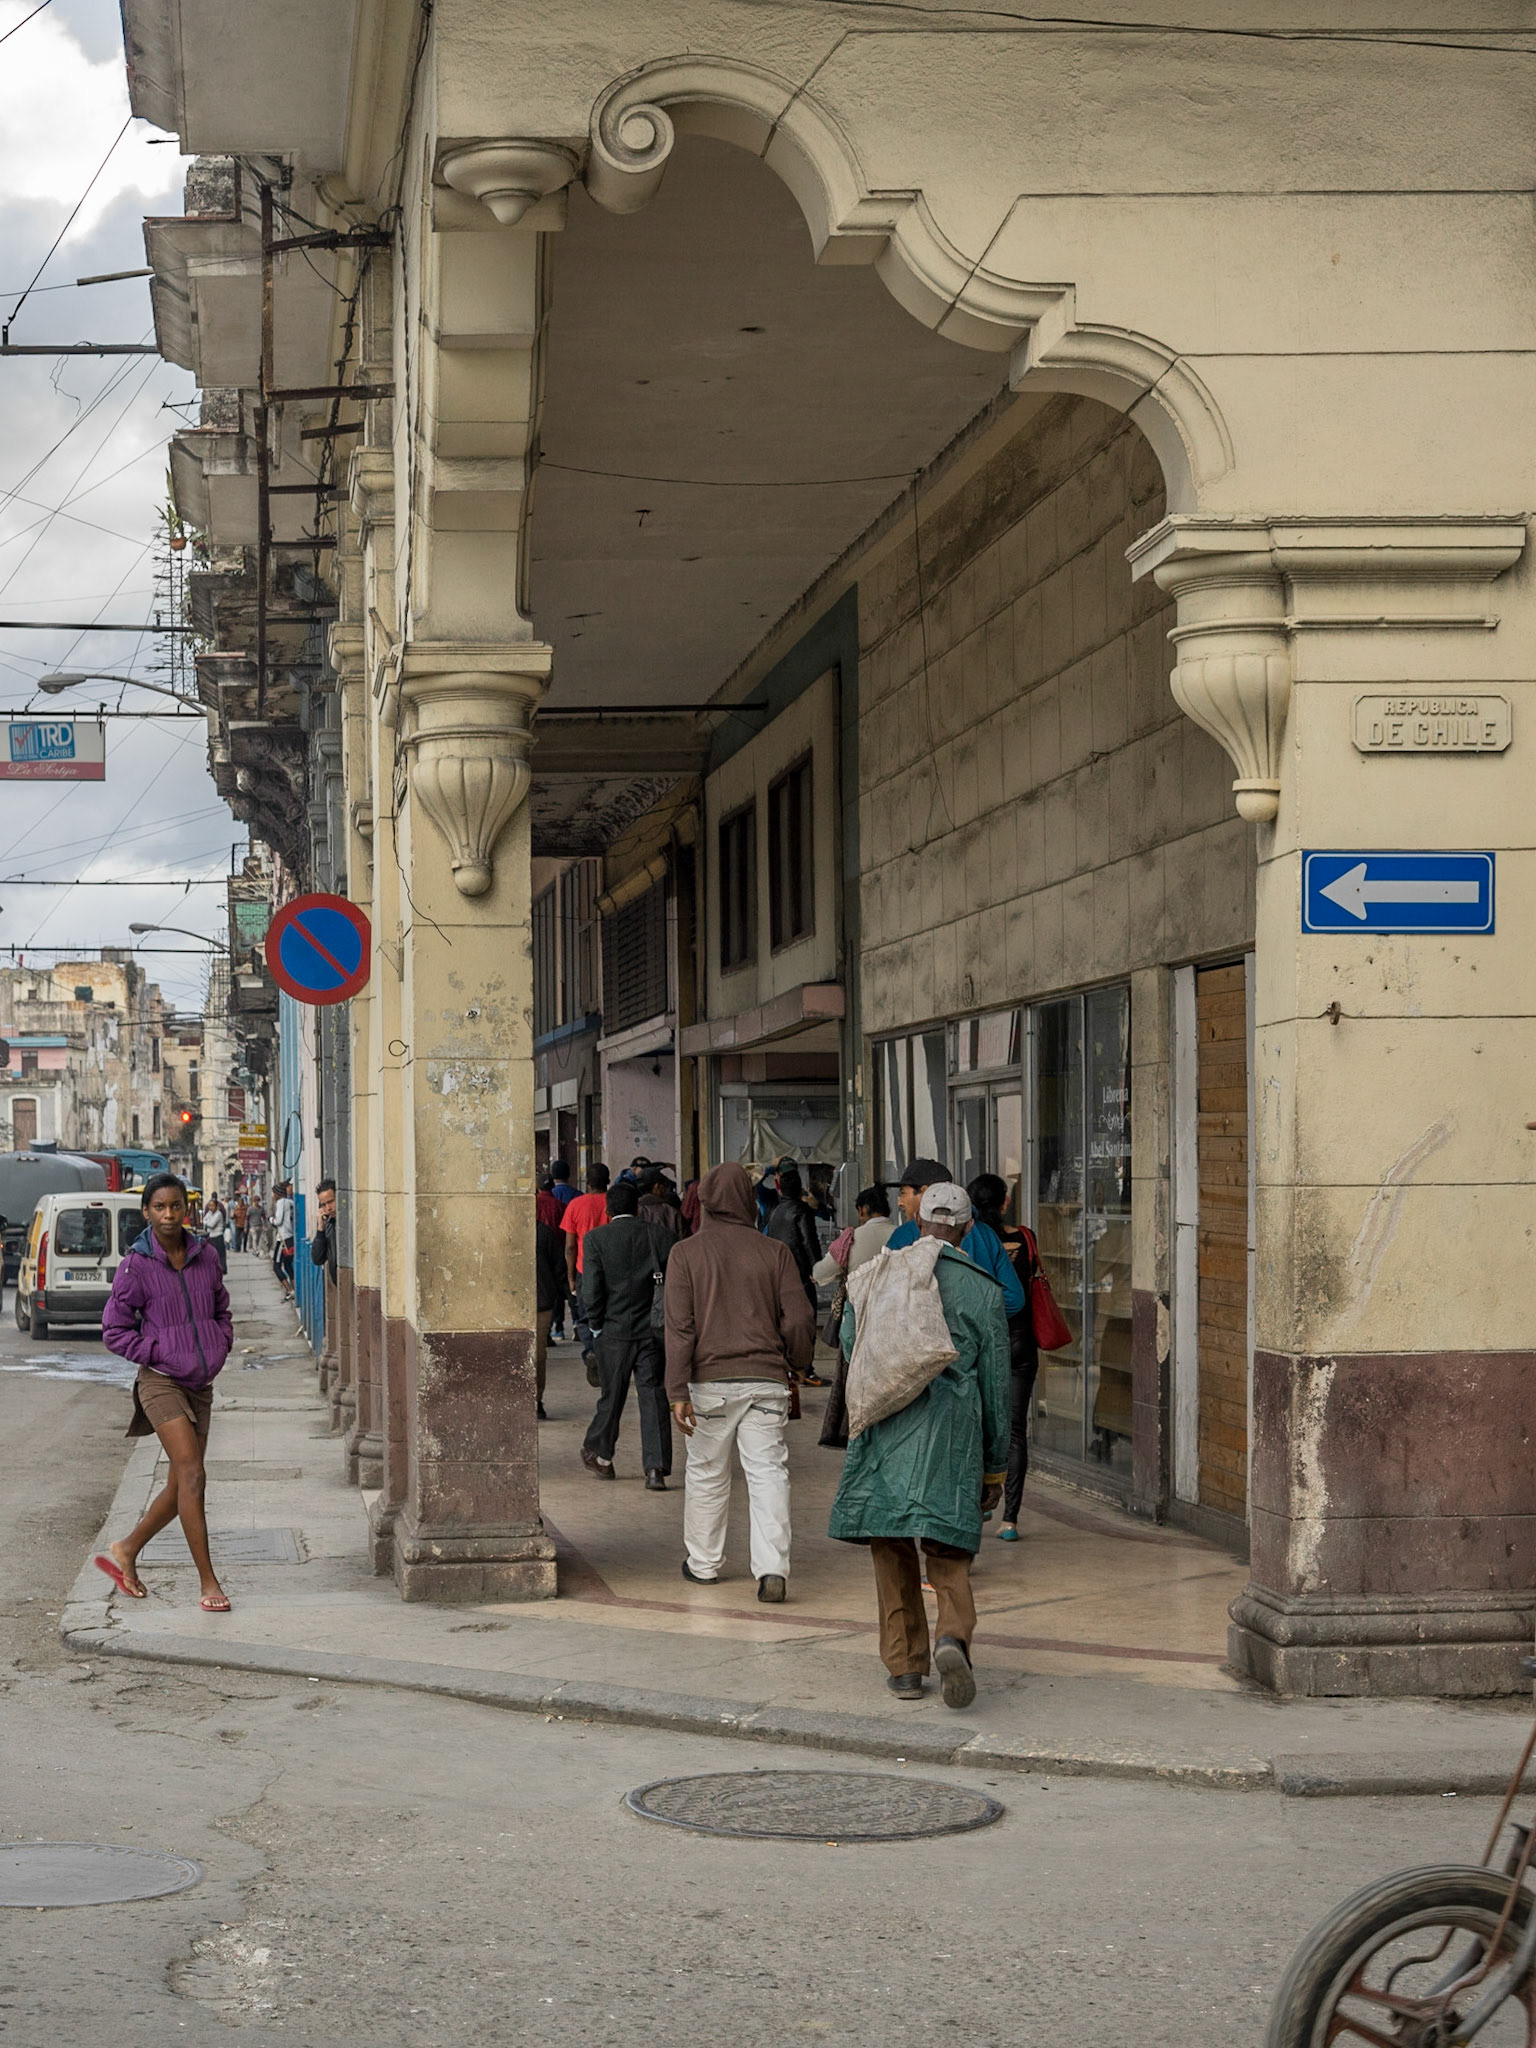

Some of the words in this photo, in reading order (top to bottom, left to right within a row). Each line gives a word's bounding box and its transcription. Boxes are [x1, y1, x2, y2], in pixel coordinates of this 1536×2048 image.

[1384, 699, 1479, 716] REPUBLICA
[38, 723, 73, 747] TRD
[1368, 719, 1404, 746] DE
[1413, 719, 1497, 746] CHILE
[39, 748, 73, 759] CARIBE
[7, 762, 31, 775] La
